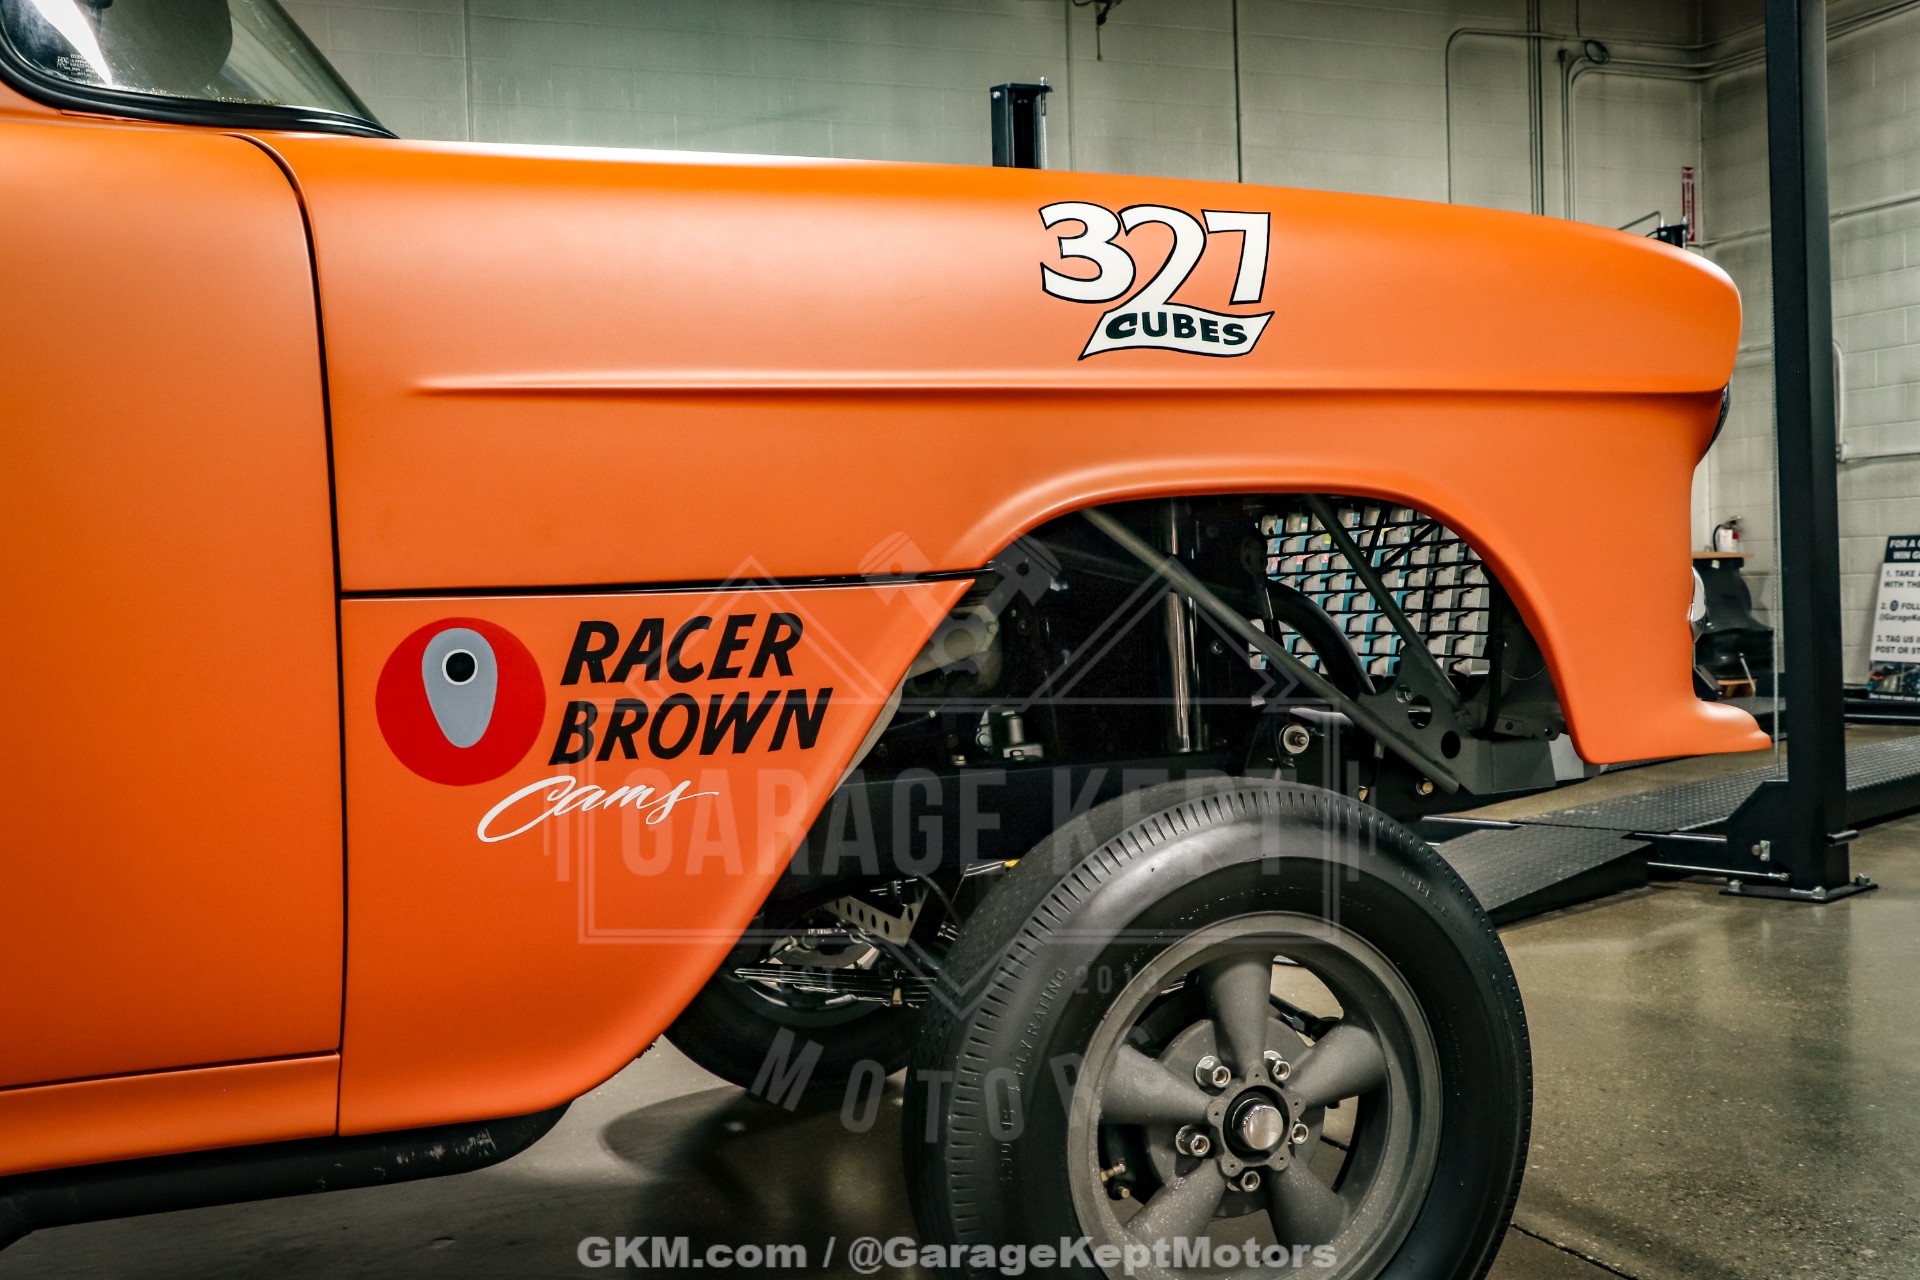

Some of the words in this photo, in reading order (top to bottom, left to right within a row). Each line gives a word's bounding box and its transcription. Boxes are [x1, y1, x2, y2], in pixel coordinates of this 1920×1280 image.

[1038, 201, 1271, 306] 327
[1105, 311, 1248, 346] CUBES
[1890, 540, 1908, 549] FOR
[1909, 540, 1916, 548] A
[1893, 551, 1911, 560] WIN
[1895, 570, 1916, 578] TAKE
[560, 612, 804, 686] RACER
[1886, 635, 1901, 643] TAG
[548, 687, 834, 766] BROWN
[476, 775, 719, 843] Cams
[1026, 967, 1068, 1038] RATING
